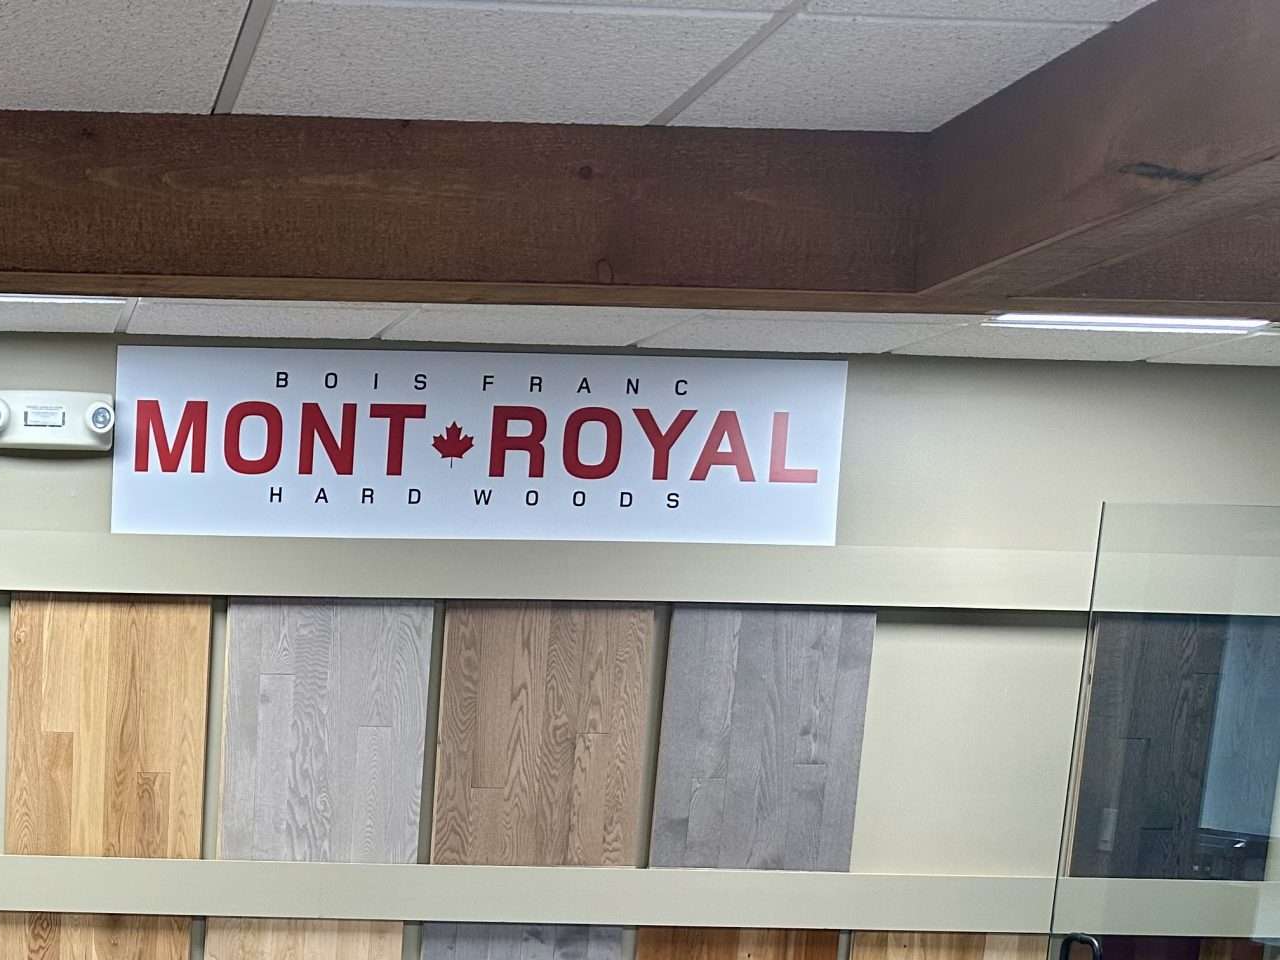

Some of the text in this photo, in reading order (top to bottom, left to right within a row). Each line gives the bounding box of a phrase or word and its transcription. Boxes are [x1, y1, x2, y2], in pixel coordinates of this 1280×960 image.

[275, 371, 689, 396] BOIS FRANC
[134, 399, 819, 484] MONT ROYAL
[269, 486, 680, 509] HARD WOODS
